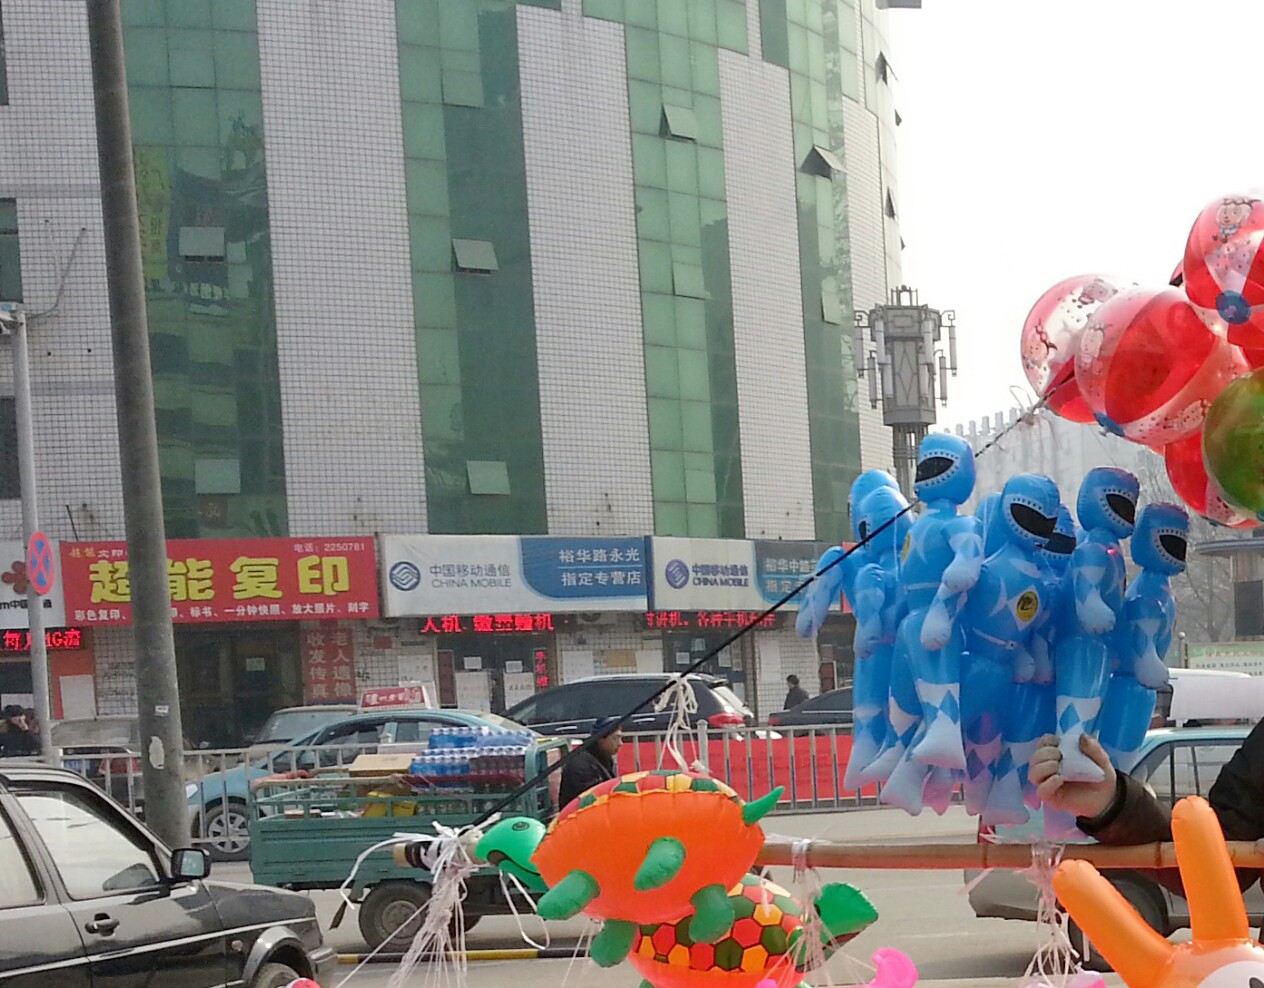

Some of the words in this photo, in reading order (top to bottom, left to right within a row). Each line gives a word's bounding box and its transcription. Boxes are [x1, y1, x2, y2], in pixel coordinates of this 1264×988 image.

[558, 548, 640, 564] 裕华路永光
[429, 563, 511, 578] 中国移动通信
[691, 564, 749, 577] 中国移动通信
[432, 578, 468, 588] CHINA
[470, 578, 511, 588] MOBILE
[561, 571, 641, 587] 指定专营店
[692, 577, 719, 587] CHINA
[720, 578, 749, 588] MOBILE
